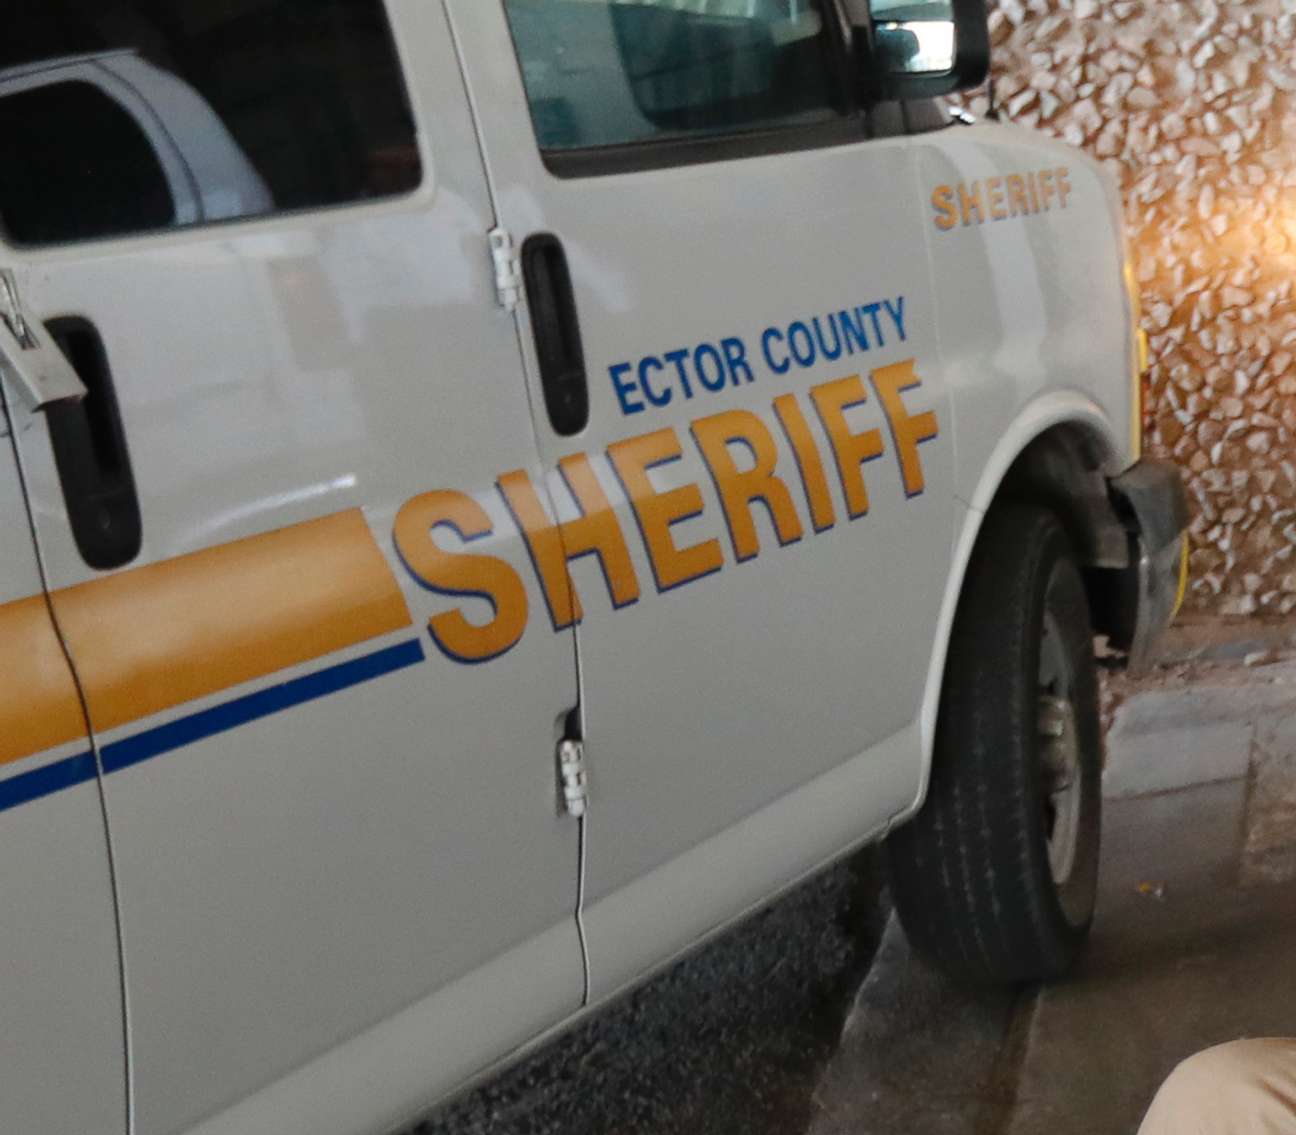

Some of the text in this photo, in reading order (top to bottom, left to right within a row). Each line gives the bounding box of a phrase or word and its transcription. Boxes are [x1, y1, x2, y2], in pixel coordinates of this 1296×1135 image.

[930, 166, 1072, 231] SHERIFF
[607, 296, 906, 417] ECTOR COUNTY
[392, 357, 939, 665] SHERIFF
